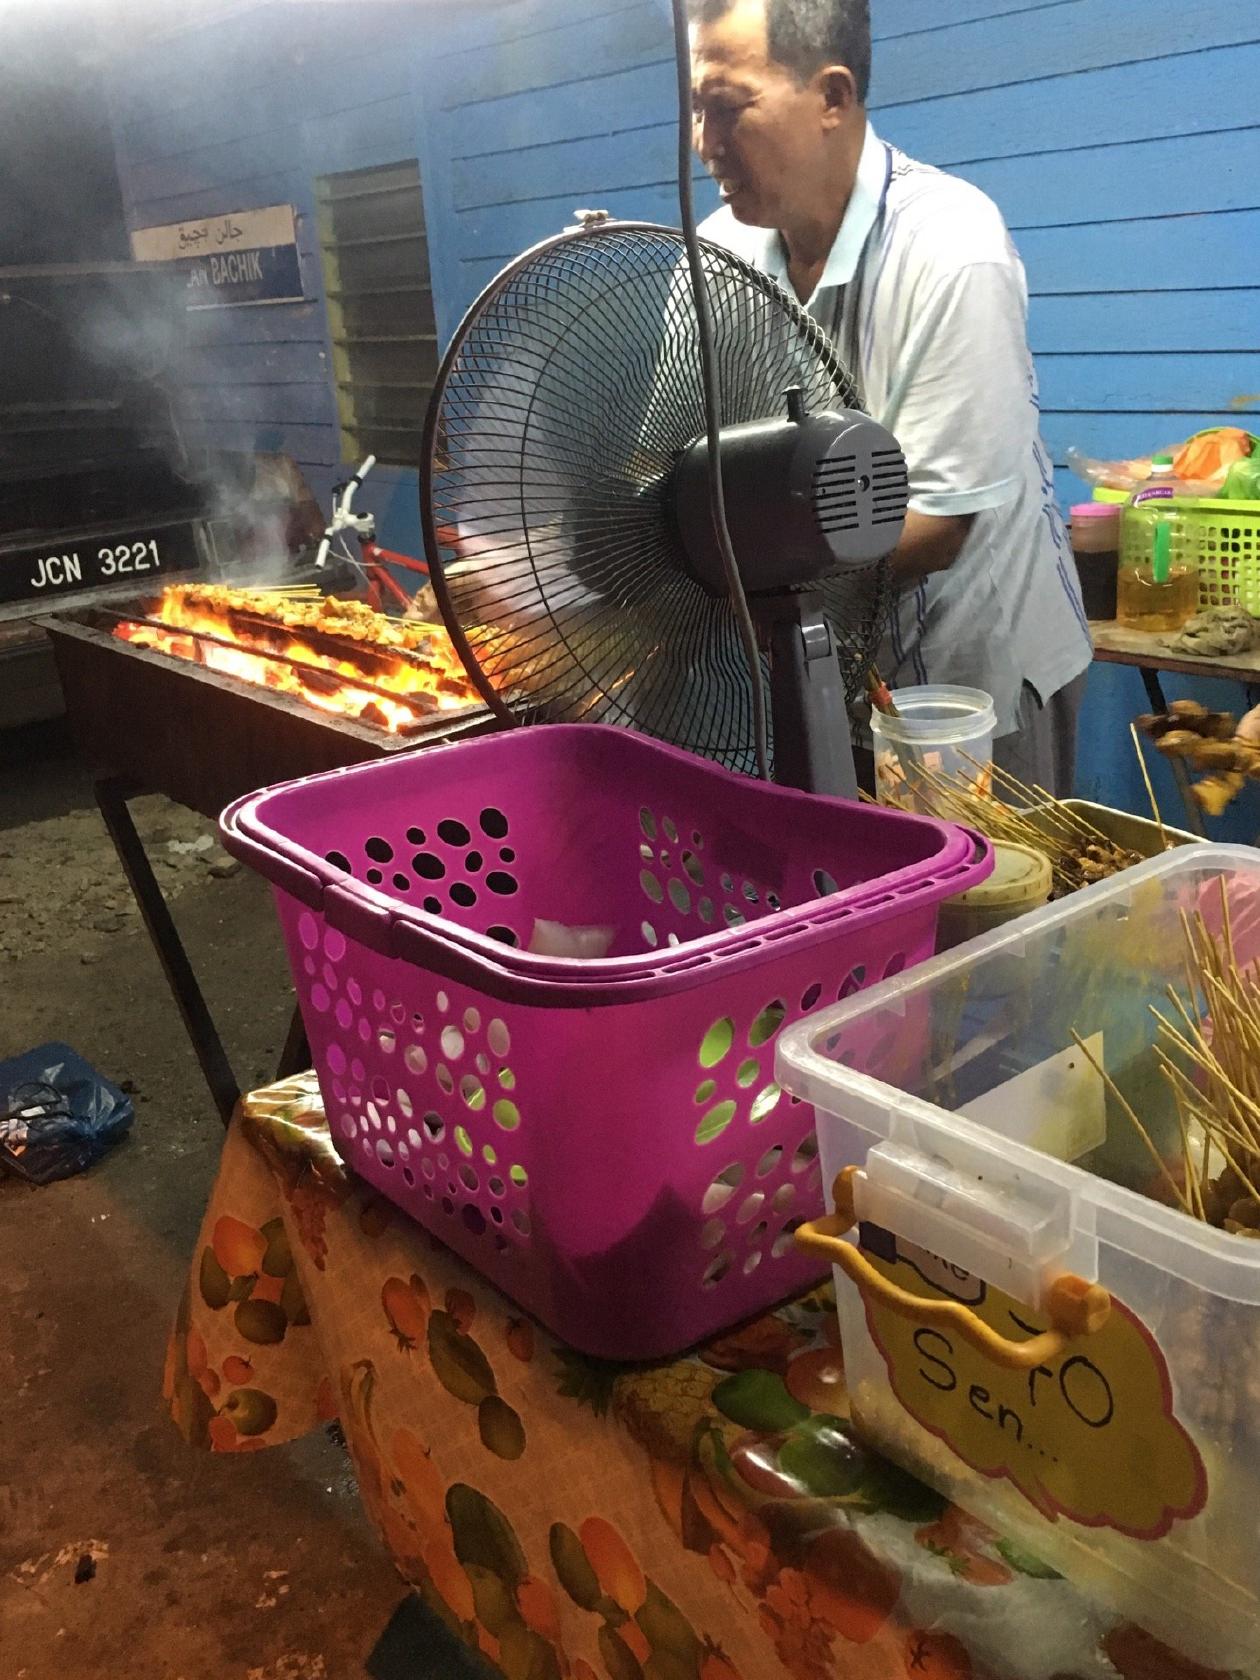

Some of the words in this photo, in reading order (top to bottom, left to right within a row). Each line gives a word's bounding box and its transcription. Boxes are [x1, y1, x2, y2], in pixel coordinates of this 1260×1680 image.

[210, 251, 263, 285] BACHIK
[30, 553, 82, 587] JCN
[98, 539, 160, 576] 3221
